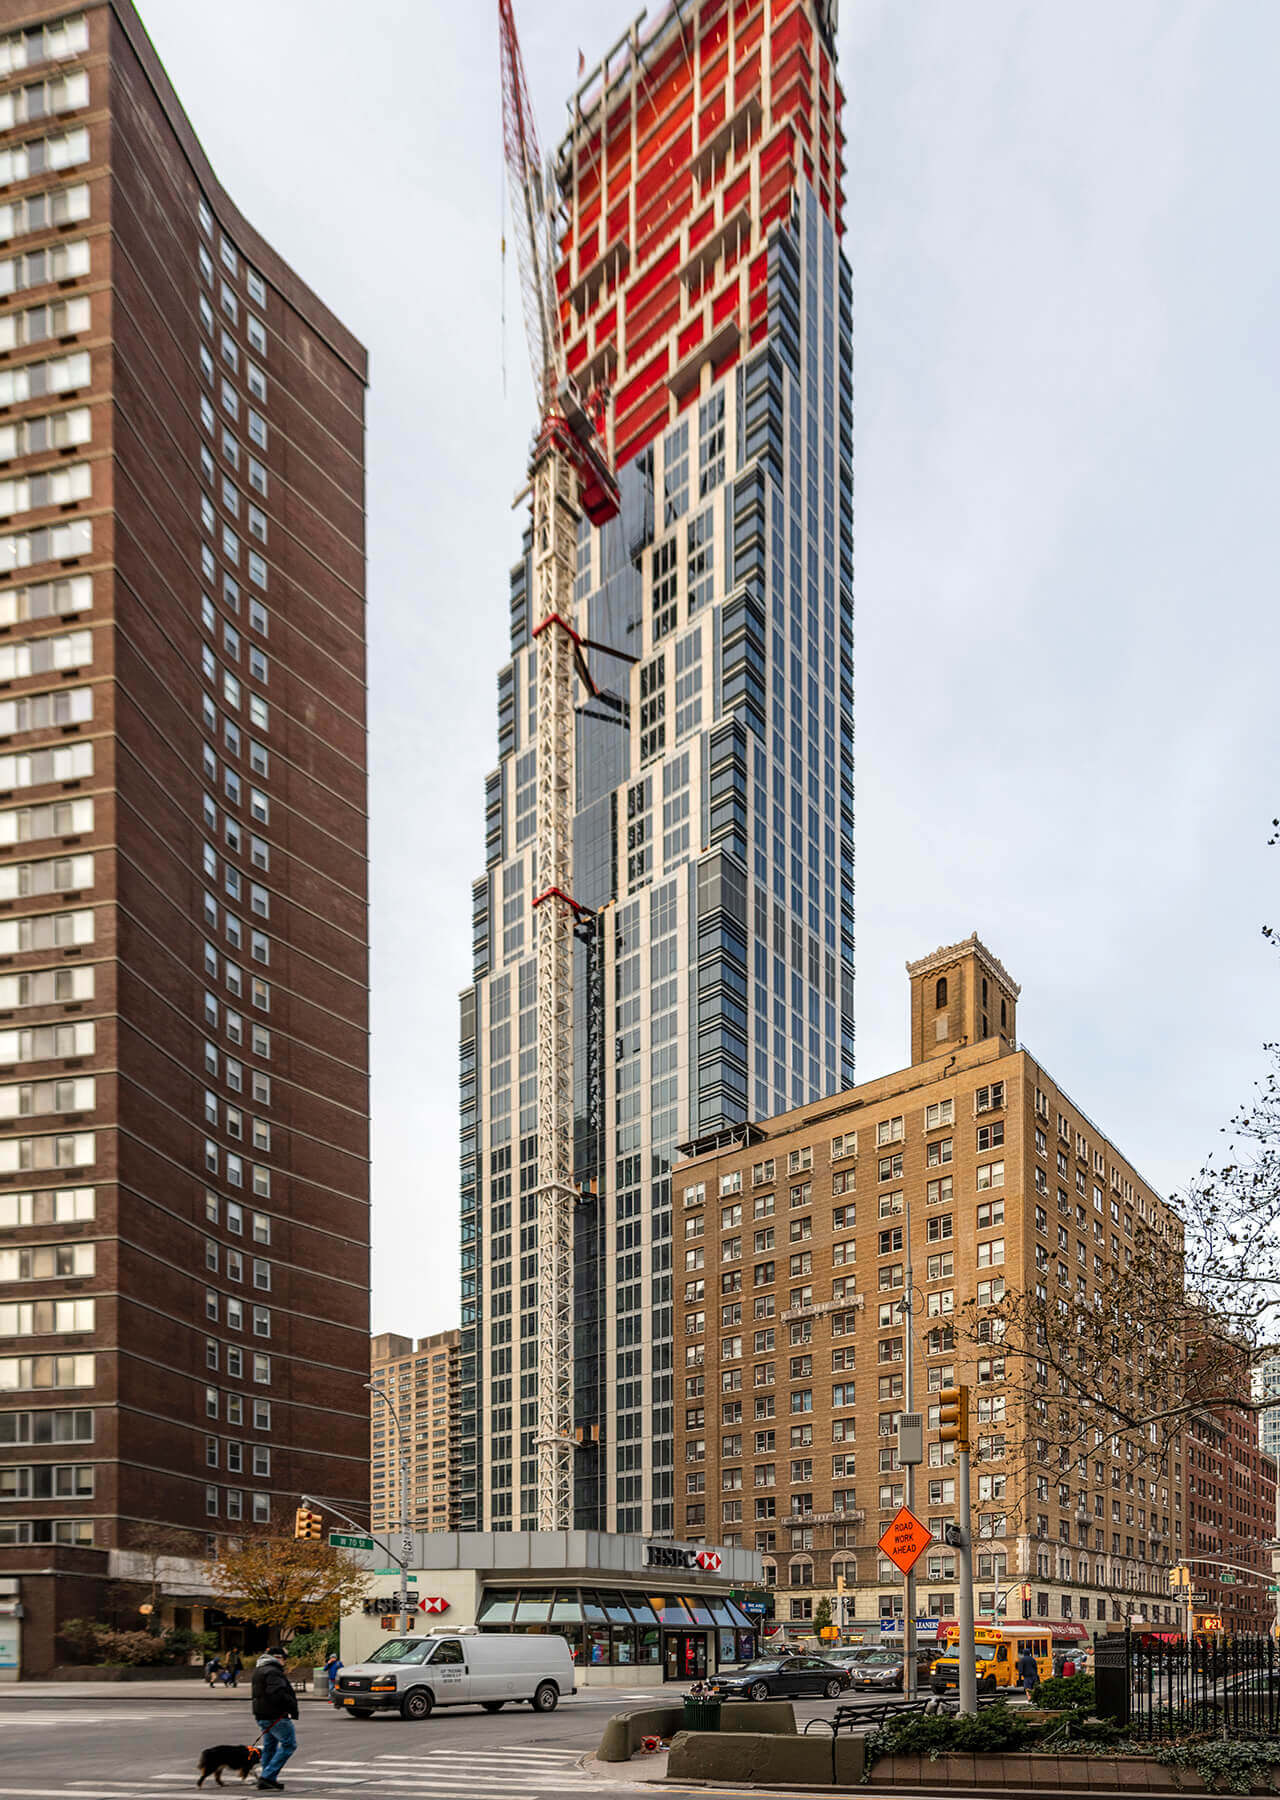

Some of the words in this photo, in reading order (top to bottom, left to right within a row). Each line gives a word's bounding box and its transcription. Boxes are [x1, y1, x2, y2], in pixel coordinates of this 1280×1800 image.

[894, 1521, 914, 1532] ROAD
[894, 1533, 914, 1544] WORK
[892, 1544, 917, 1555] AHEAD
[647, 1546, 697, 1568] HSBC
[915, 1620, 940, 1630] LEANERS
